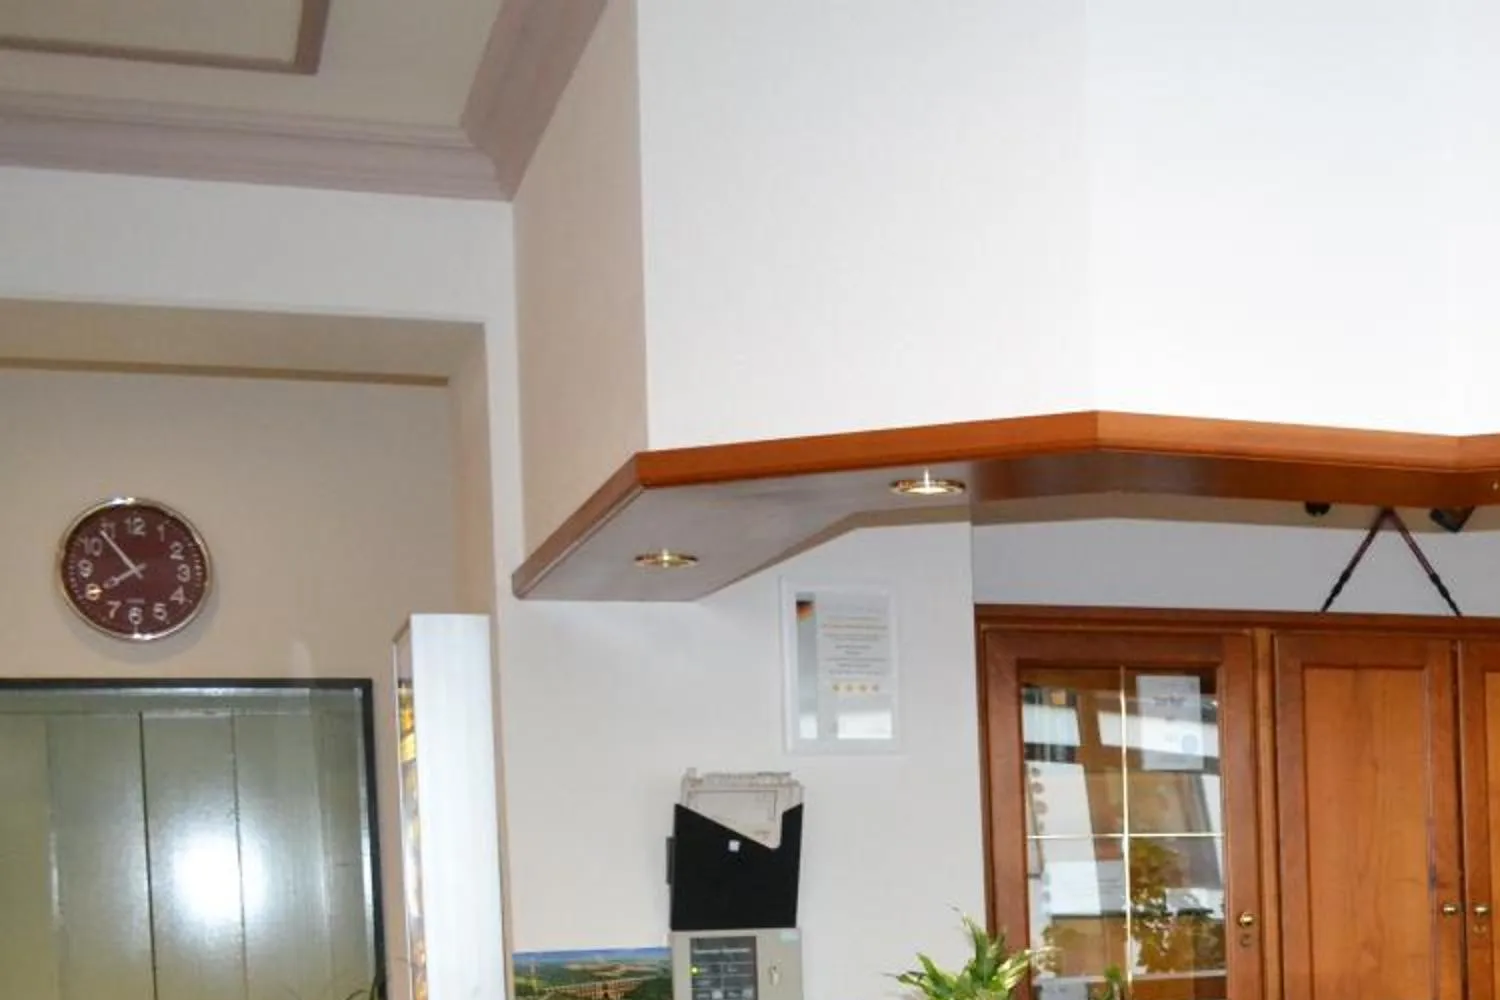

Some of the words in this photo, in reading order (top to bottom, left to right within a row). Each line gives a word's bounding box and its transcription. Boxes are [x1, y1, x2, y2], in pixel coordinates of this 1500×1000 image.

[124, 516, 146, 537] 12
[156, 523, 165, 542] 1
[79, 536, 103, 557] 10
[169, 541, 185, 561] 2
[77, 559, 93, 578] 9
[176, 563, 191, 583] 3
[169, 585, 187, 605] 4
[106, 601, 122, 620] 7
[127, 606, 143, 625] 6
[152, 602, 168, 621] 5
